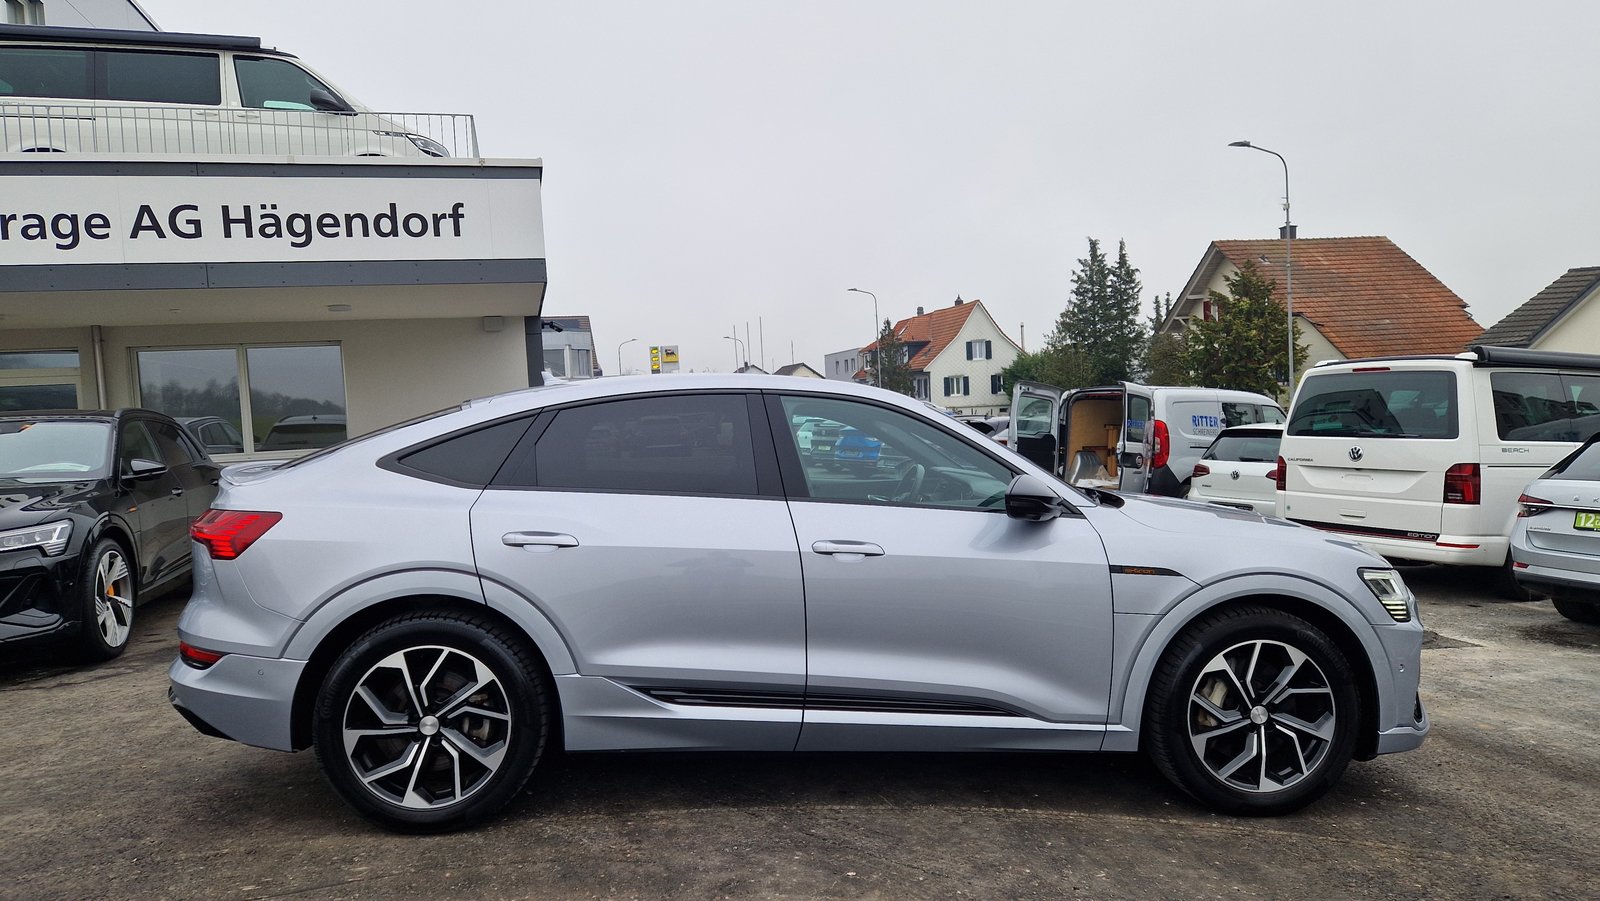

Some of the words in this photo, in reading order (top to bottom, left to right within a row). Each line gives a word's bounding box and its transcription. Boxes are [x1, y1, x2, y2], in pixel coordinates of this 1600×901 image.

[0, 211, 111, 250] rage
[129, 204, 204, 239] AG
[220, 202, 465, 247] Hägendorf
[1192, 415, 1219, 427] RITTER
[1580, 513, 1595, 527] 12
